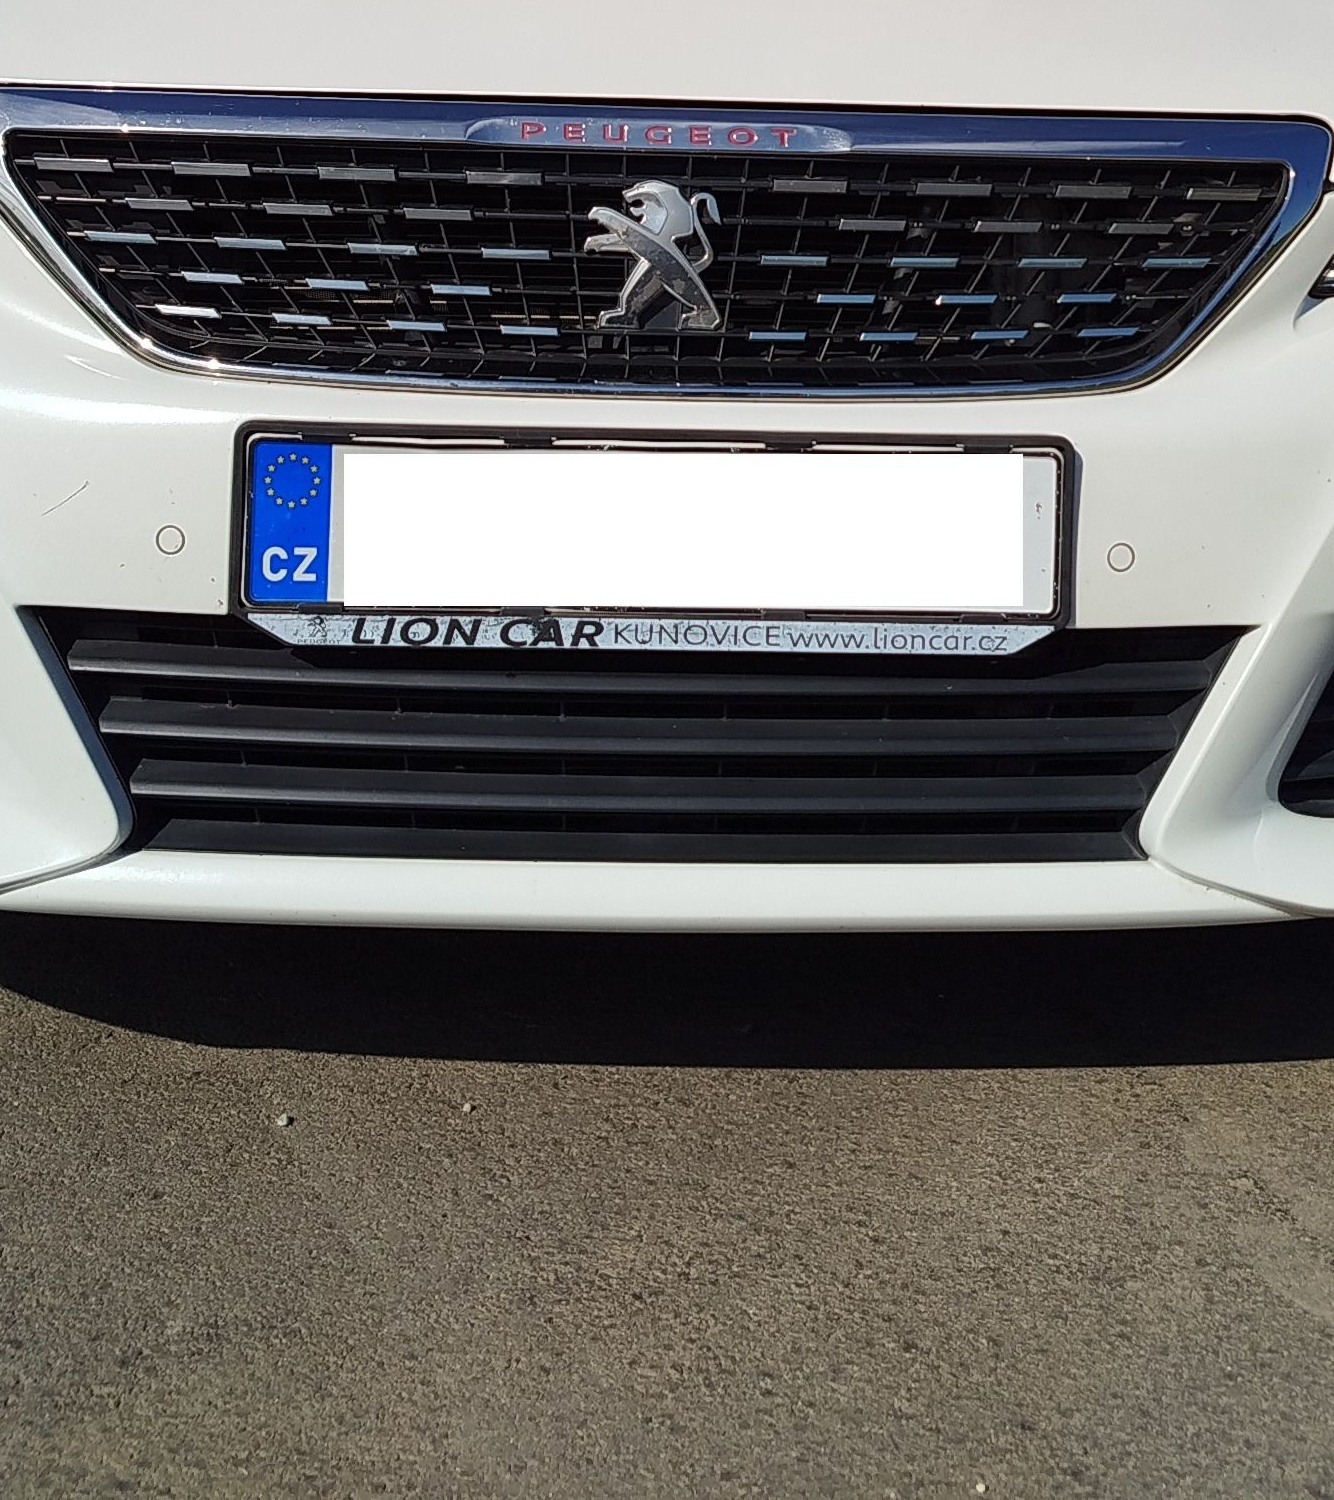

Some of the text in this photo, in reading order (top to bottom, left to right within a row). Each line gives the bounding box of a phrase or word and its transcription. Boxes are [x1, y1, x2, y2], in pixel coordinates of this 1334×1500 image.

[521, 121, 797, 148] PEUGEOT
[262, 546, 318, 582] CZ
[352, 617, 1008, 652] LION CAR KUNOVICE www.lioncar.cz
